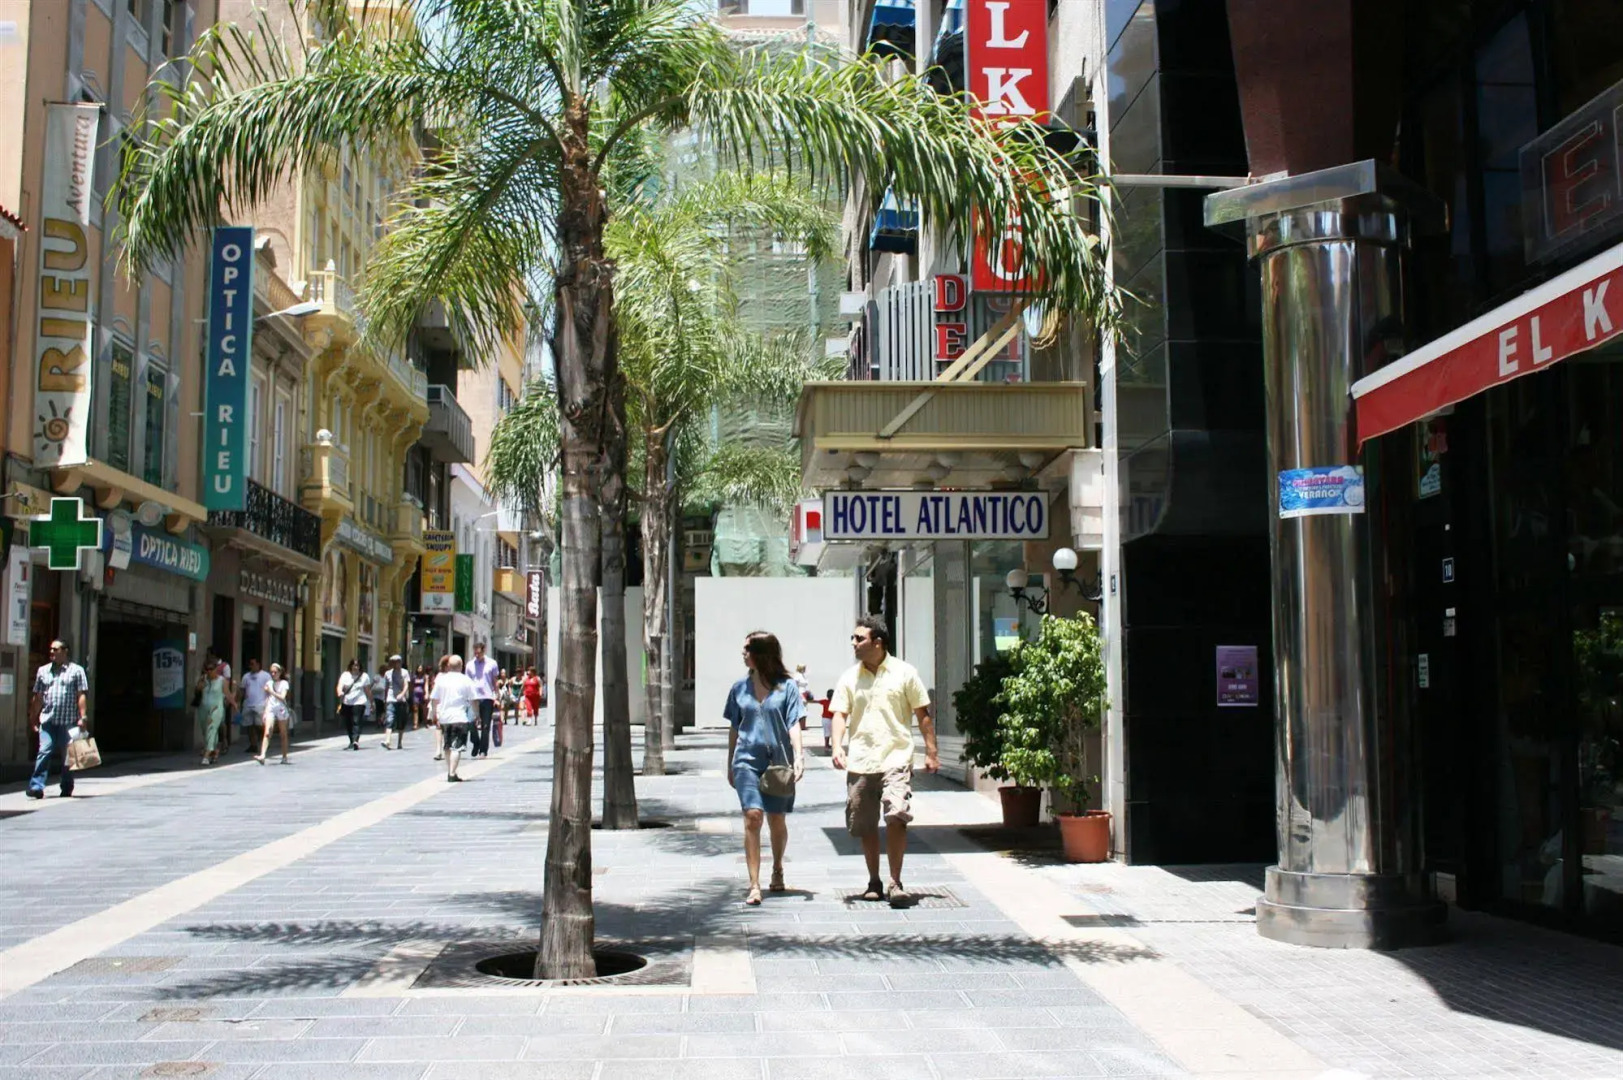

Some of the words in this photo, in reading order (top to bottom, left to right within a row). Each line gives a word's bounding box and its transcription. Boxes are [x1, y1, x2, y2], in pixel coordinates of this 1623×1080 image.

[39, 217, 89, 393] RIEU
[66, 115, 91, 214] Aventura
[218, 243, 243, 377] OPTICA
[1498, 316, 1553, 377] EL
[1582, 278, 1613, 342] K
[214, 405, 234, 494] RIEU
[832, 495, 906, 533] HOTEL
[916, 495, 1043, 533] ATLANTICO
[1299, 489, 1336, 500] VERANO
[140, 534, 178, 566] OPTICA
[180, 545, 201, 574] RIEU
[527, 573, 542, 618] Bata
[154, 651, 183, 669] 15%
